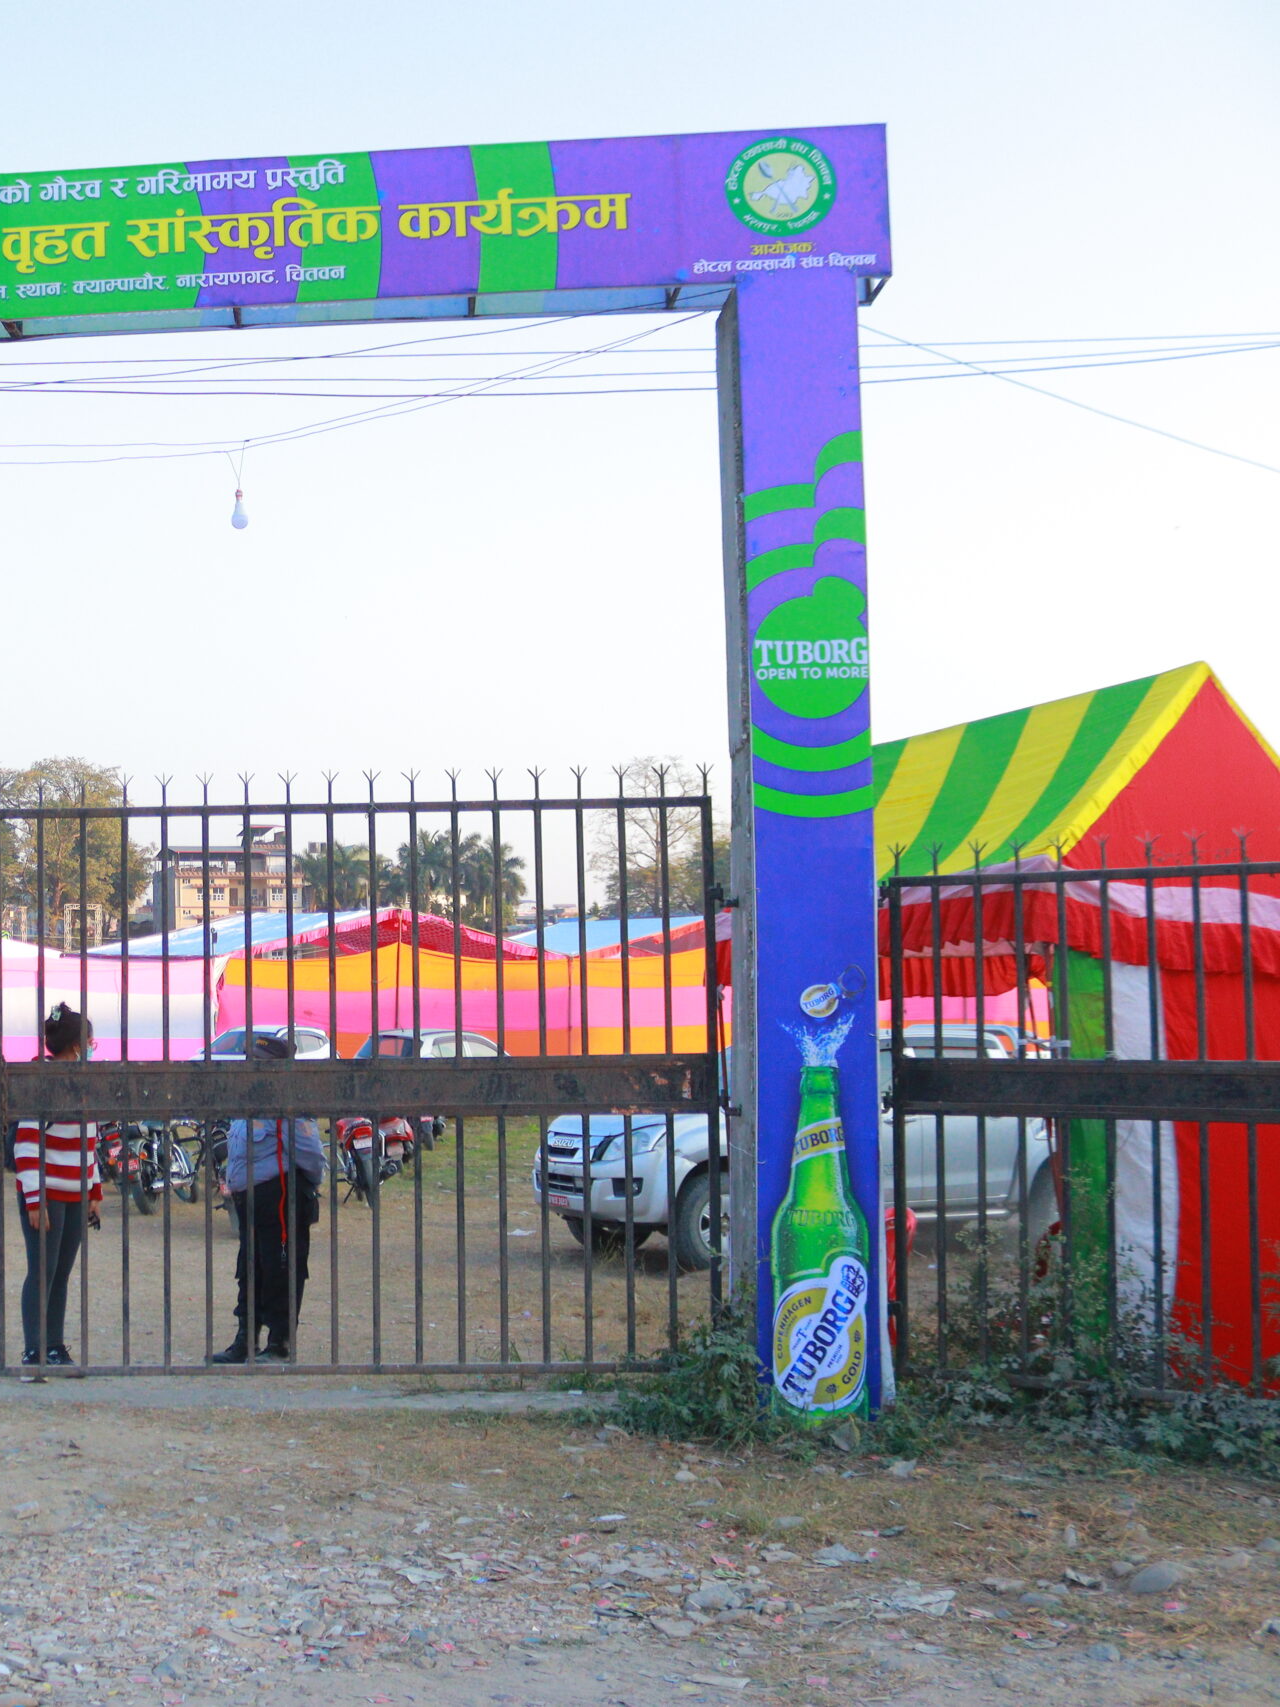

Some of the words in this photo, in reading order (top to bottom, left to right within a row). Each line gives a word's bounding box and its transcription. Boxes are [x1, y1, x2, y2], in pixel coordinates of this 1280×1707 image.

[40, 175, 102, 202] गौरव
[110, 177, 129, 197] र
[137, 163, 257, 196] गरिमामय
[264, 158, 348, 192] प्रस्तुति
[2, 221, 110, 274] वृहत
[126, 196, 381, 259] सांस्कृतिक
[398, 188, 632, 240] कार्यक्रम
[285, 262, 347, 283] चितवन
[693, 259, 731, 274] होटल
[755, 637, 868, 667] TUBORG
[756, 667, 797, 680] OPEN
[800, 667, 822, 679] TO
[826, 666, 869, 678] MORE
[803, 988, 834, 1009] TUBORG
[777, 1296, 812, 1360] COPENHAGEN
[782, 1289, 856, 1394] TUBORG
[841, 1351, 862, 1385] GOLD
